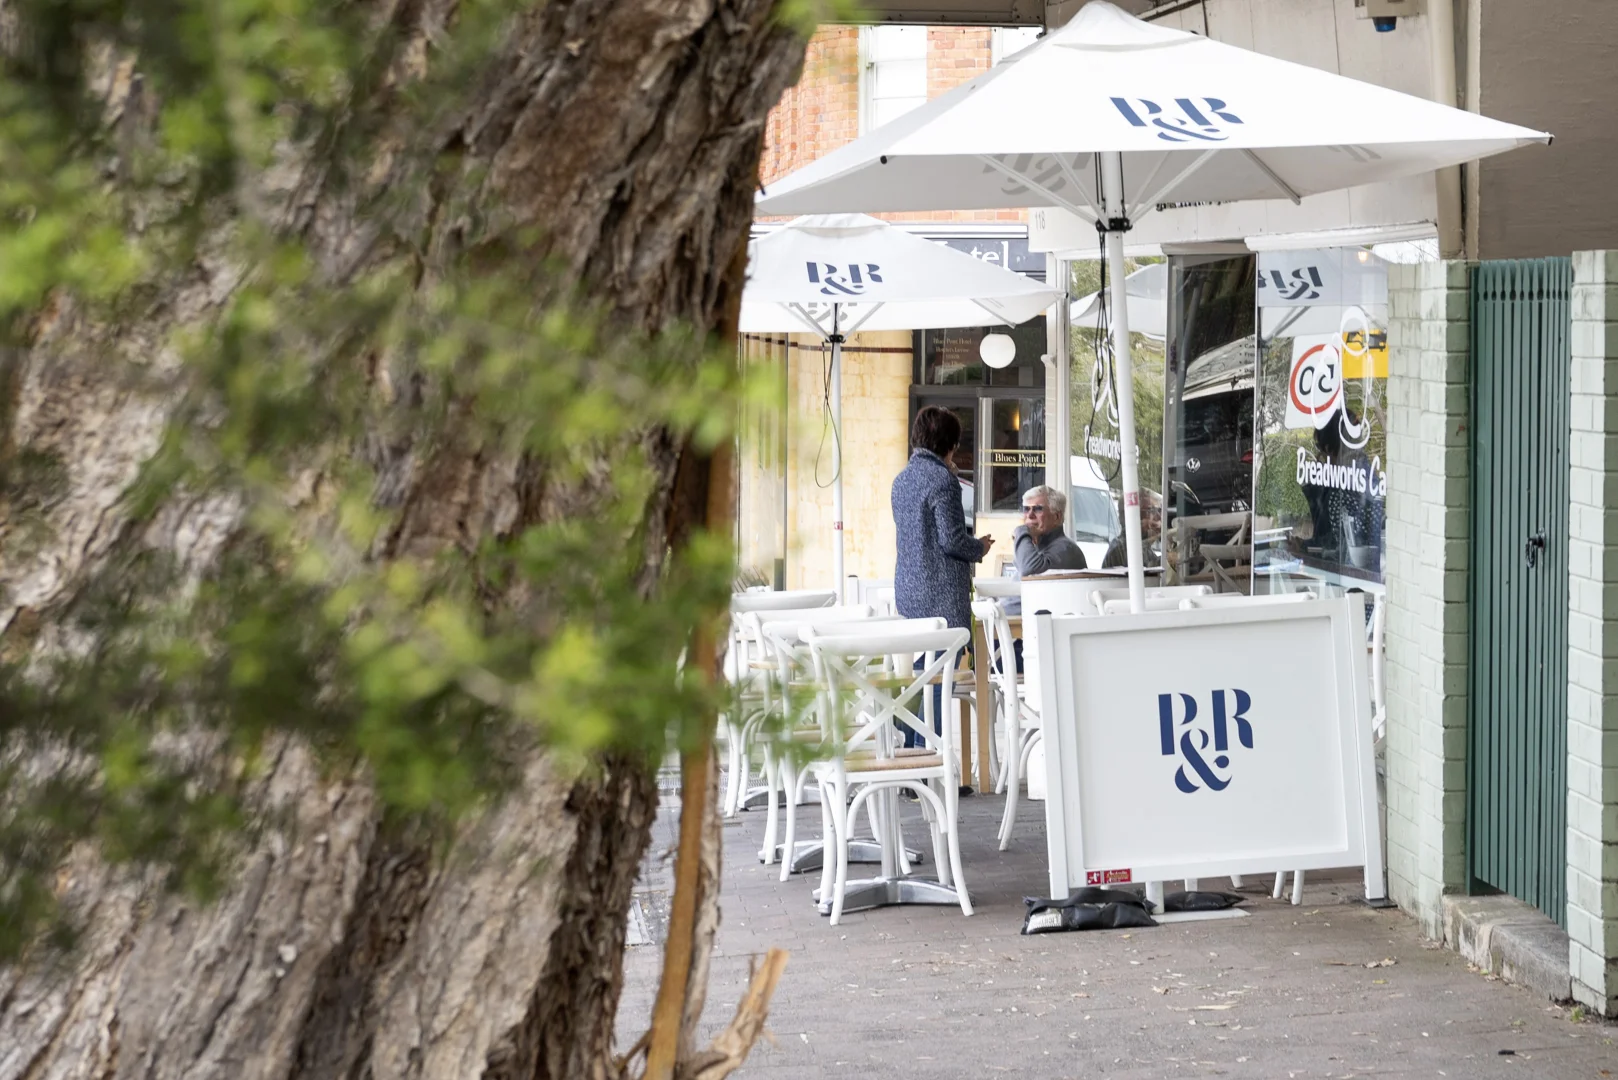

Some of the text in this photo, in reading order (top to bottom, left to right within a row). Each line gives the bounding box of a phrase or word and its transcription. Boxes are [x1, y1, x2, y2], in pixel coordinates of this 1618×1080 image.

[995, 453, 1017, 462] Blues
[1018, 453, 1039, 463] Point
[1296, 446, 1367, 494] Breadworks
